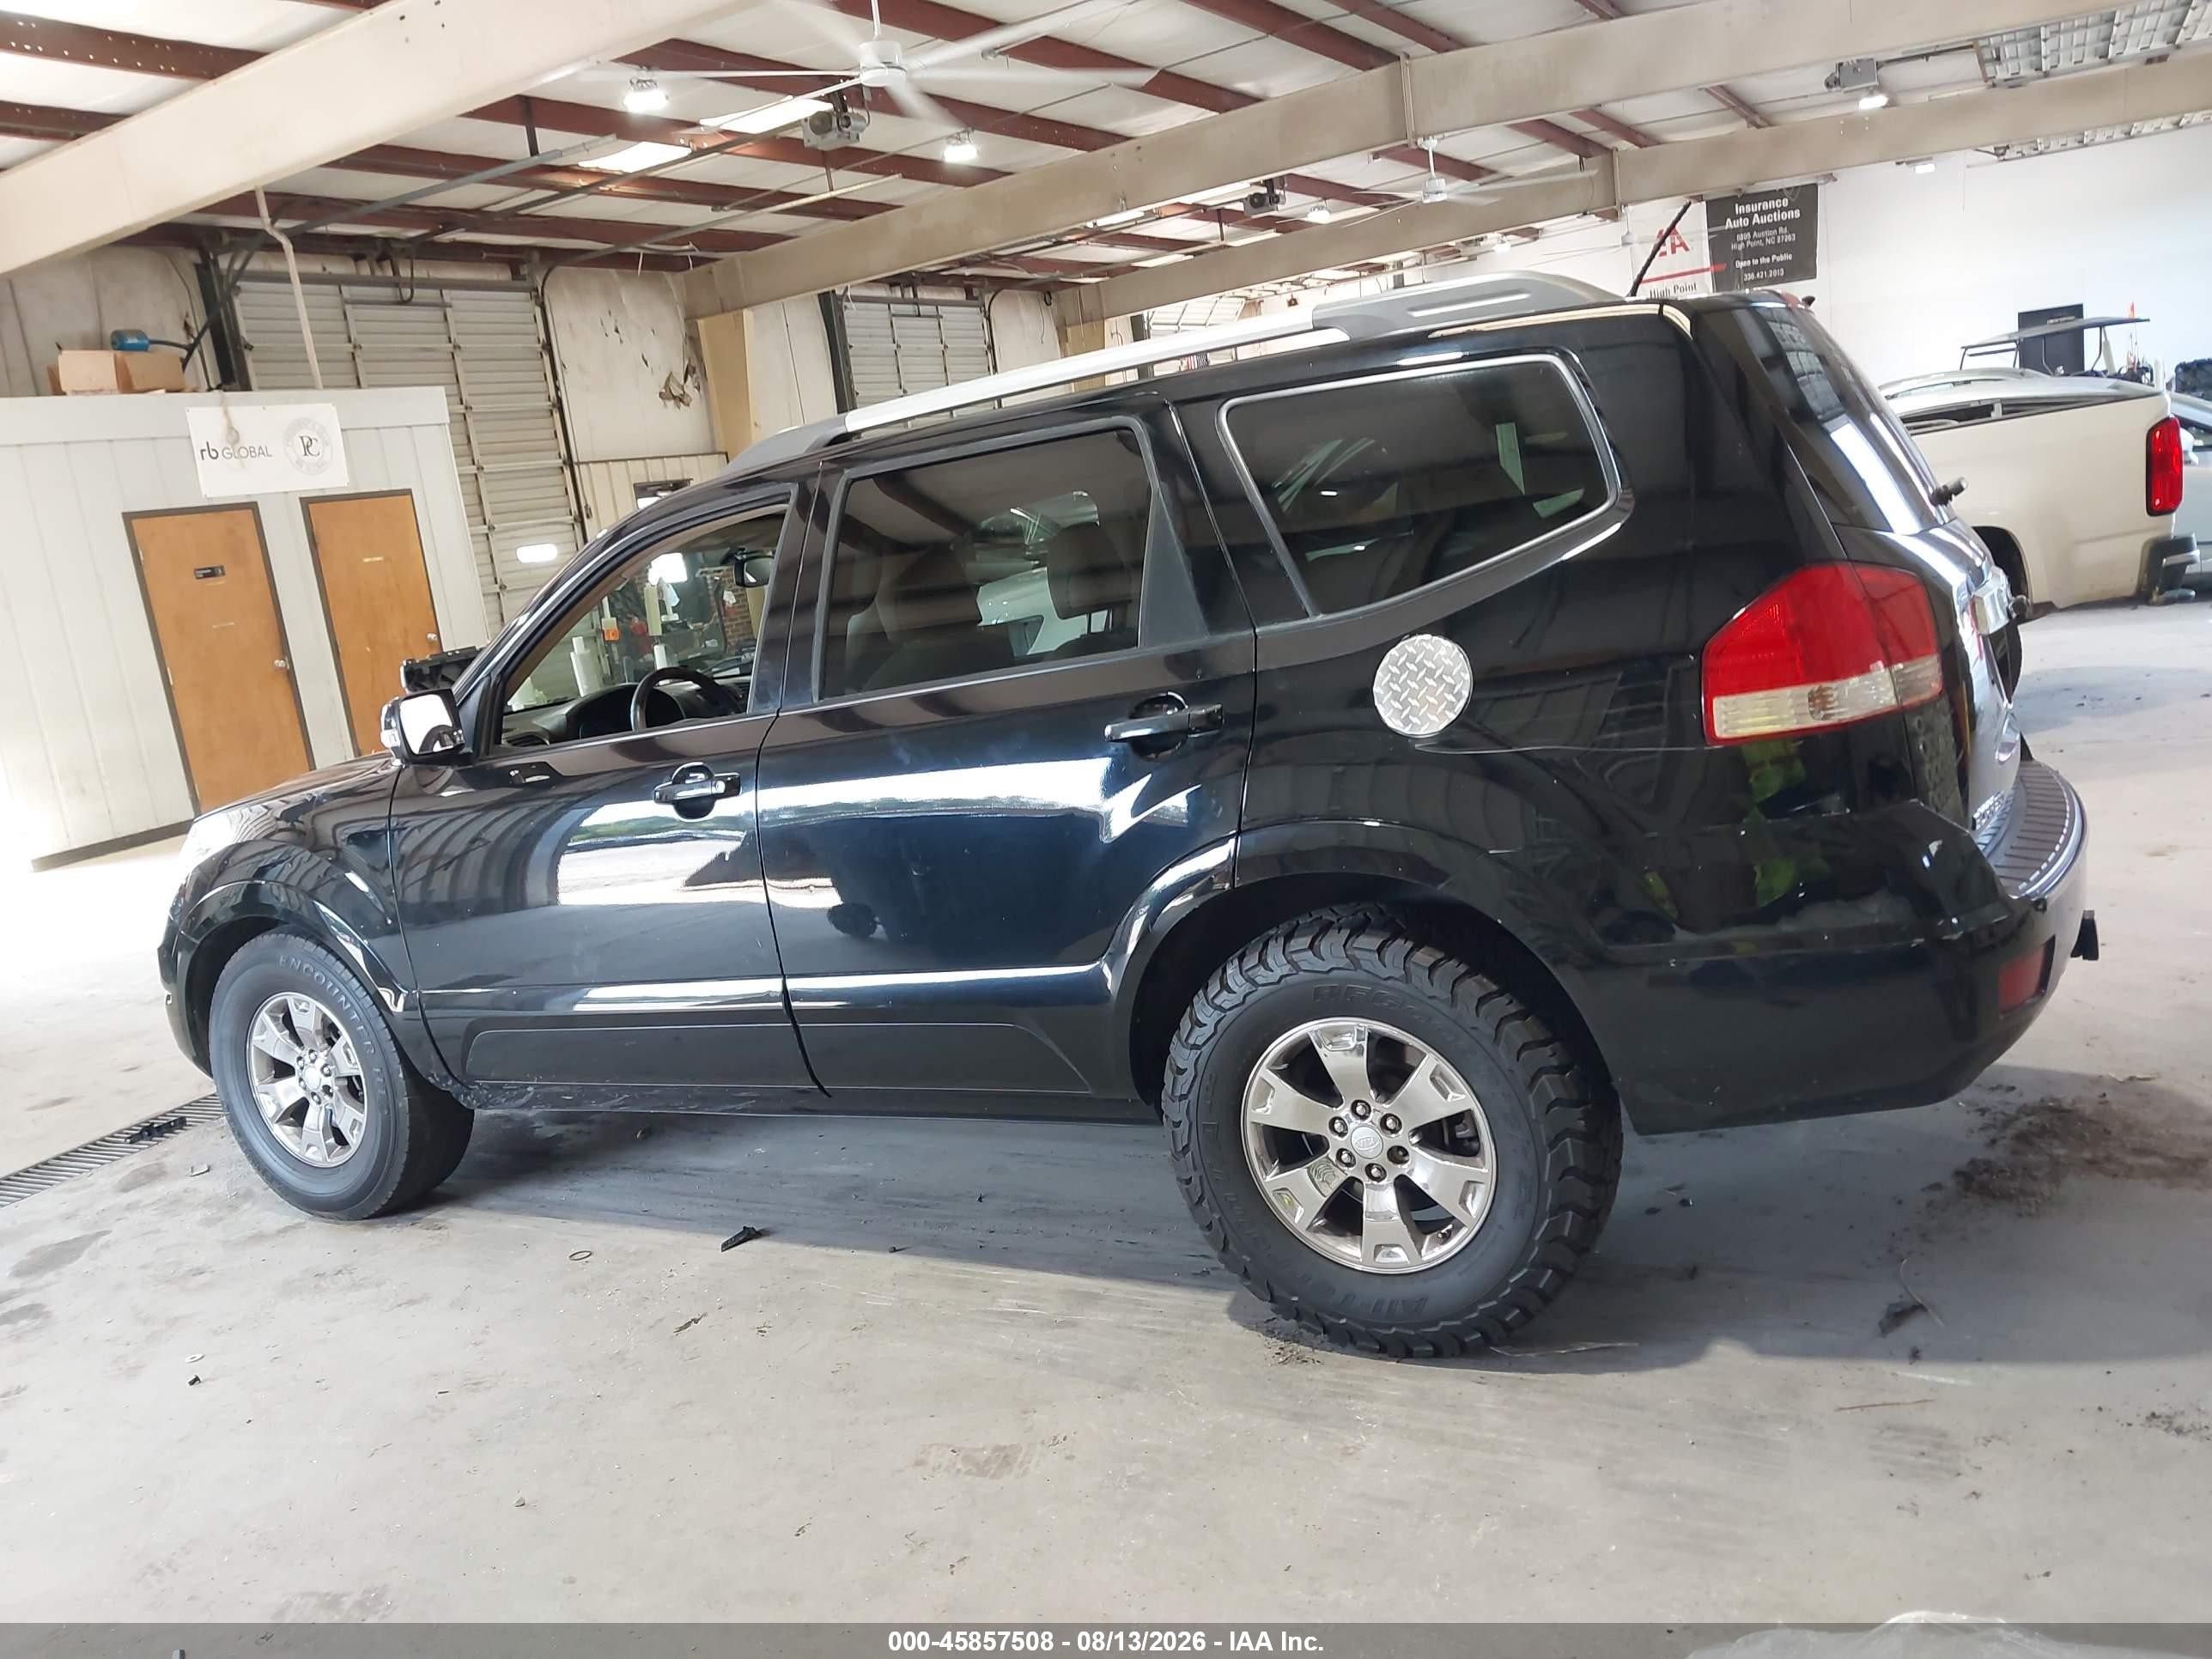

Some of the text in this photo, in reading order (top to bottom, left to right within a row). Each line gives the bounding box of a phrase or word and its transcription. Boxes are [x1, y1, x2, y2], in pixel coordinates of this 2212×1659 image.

[1735, 198, 1789, 215] Insurance
[1724, 208, 1801, 230] Auto Auctions
[1731, 241, 1745, 251] High
[1765, 236, 1776, 245] NC
[1735, 259, 1751, 269] Open
[1759, 255, 1771, 264] the
[1771, 253, 1793, 263] Public
[1674, 282, 1697, 294] Point
[222, 445, 273, 460] GLOBAL
